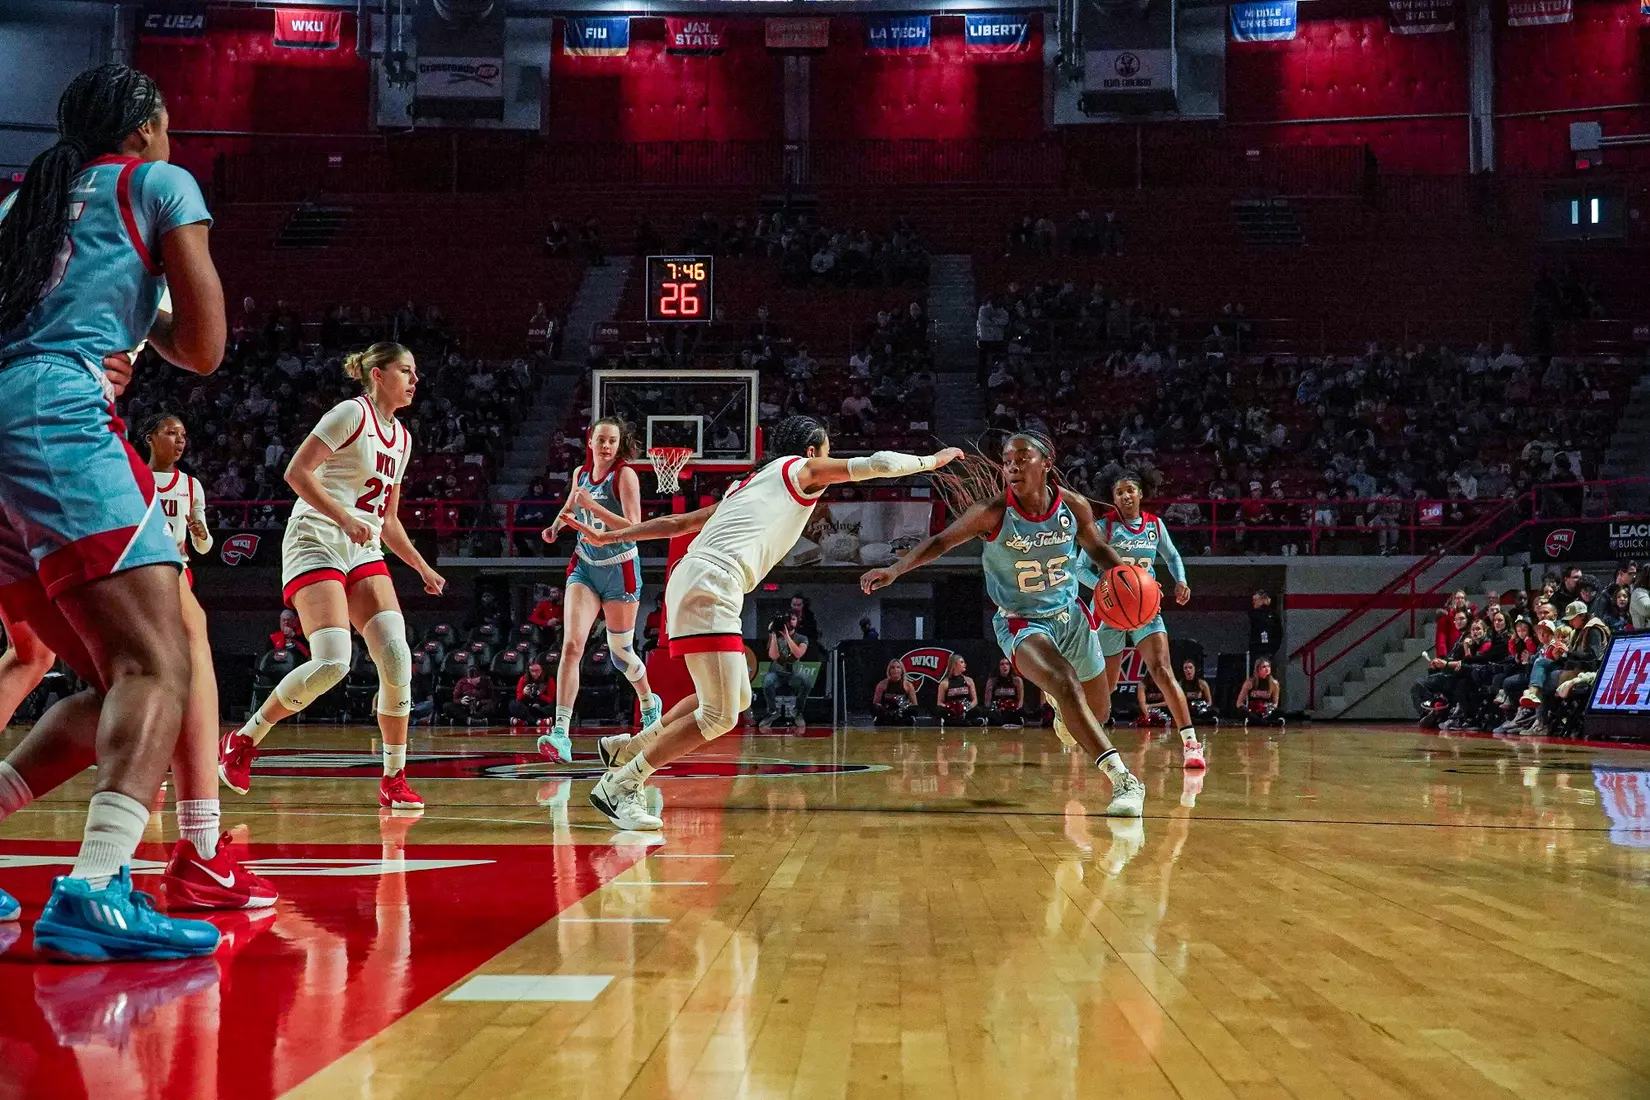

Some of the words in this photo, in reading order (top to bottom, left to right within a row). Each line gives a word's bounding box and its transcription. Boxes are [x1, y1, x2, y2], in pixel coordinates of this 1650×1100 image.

[162, 14, 206, 28] USA
[291, 20, 323, 32] WKU
[585, 27, 608, 39] FIU
[870, 27, 887, 39] LA
[891, 26, 926, 39] TECH
[969, 23, 1028, 37] LIBERTY
[675, 34, 719, 46] STATE
[667, 263, 706, 280] 7:46
[660, 283, 699, 315] 26
[376, 451, 396, 479] WKU
[355, 477, 393, 518] 23
[811, 519, 864, 532] Goodness
[232, 539, 251, 550] WKU
[1005, 532, 1033, 554] Lady
[1553, 533, 1569, 543] WKU
[1618, 539, 1644, 549] BUICK
[910, 655, 939, 669] WKU
